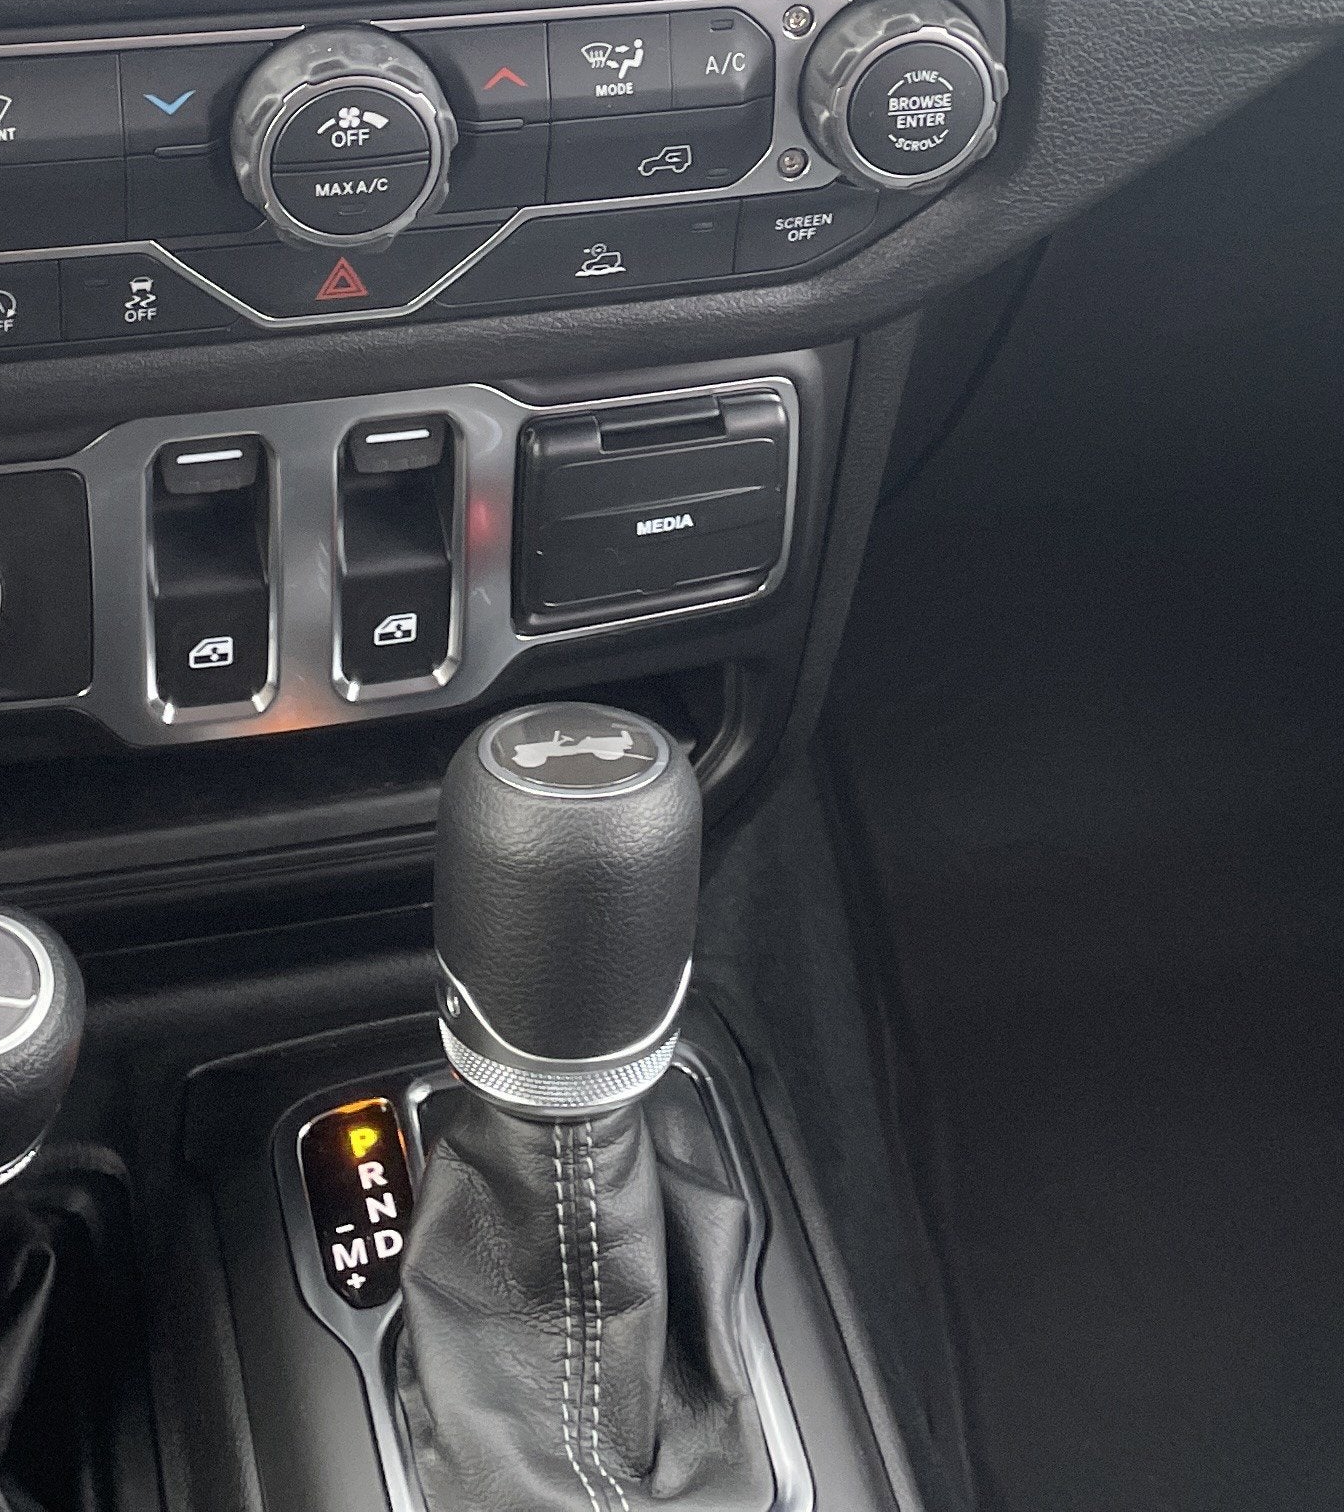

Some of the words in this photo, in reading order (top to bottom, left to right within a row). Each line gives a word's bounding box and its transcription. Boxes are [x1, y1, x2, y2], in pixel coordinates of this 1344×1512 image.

[705, 53, 747, 76] A/C
[903, 70, 940, 86] TUNE
[595, 82, 634, 97] MODE
[889, 93, 952, 111] BROWSE
[896, 112, 946, 129] ENTER
[330, 128, 371, 149] OFF
[895, 133, 944, 153] SCROLL
[315, 180, 354, 198] MAX
[355, 176, 389, 194] A/C
[774, 212, 833, 231] SCREEN
[787, 227, 817, 243] OFF
[123, 307, 158, 324] OFF
[636, 513, 695, 537] MEDIA
[349, 1127, 380, 1159] P
[358, 1161, 388, 1190] R
[365, 1192, 398, 1224] N
[331, 1237, 370, 1272] M
[373, 1229, 404, 1259] D
